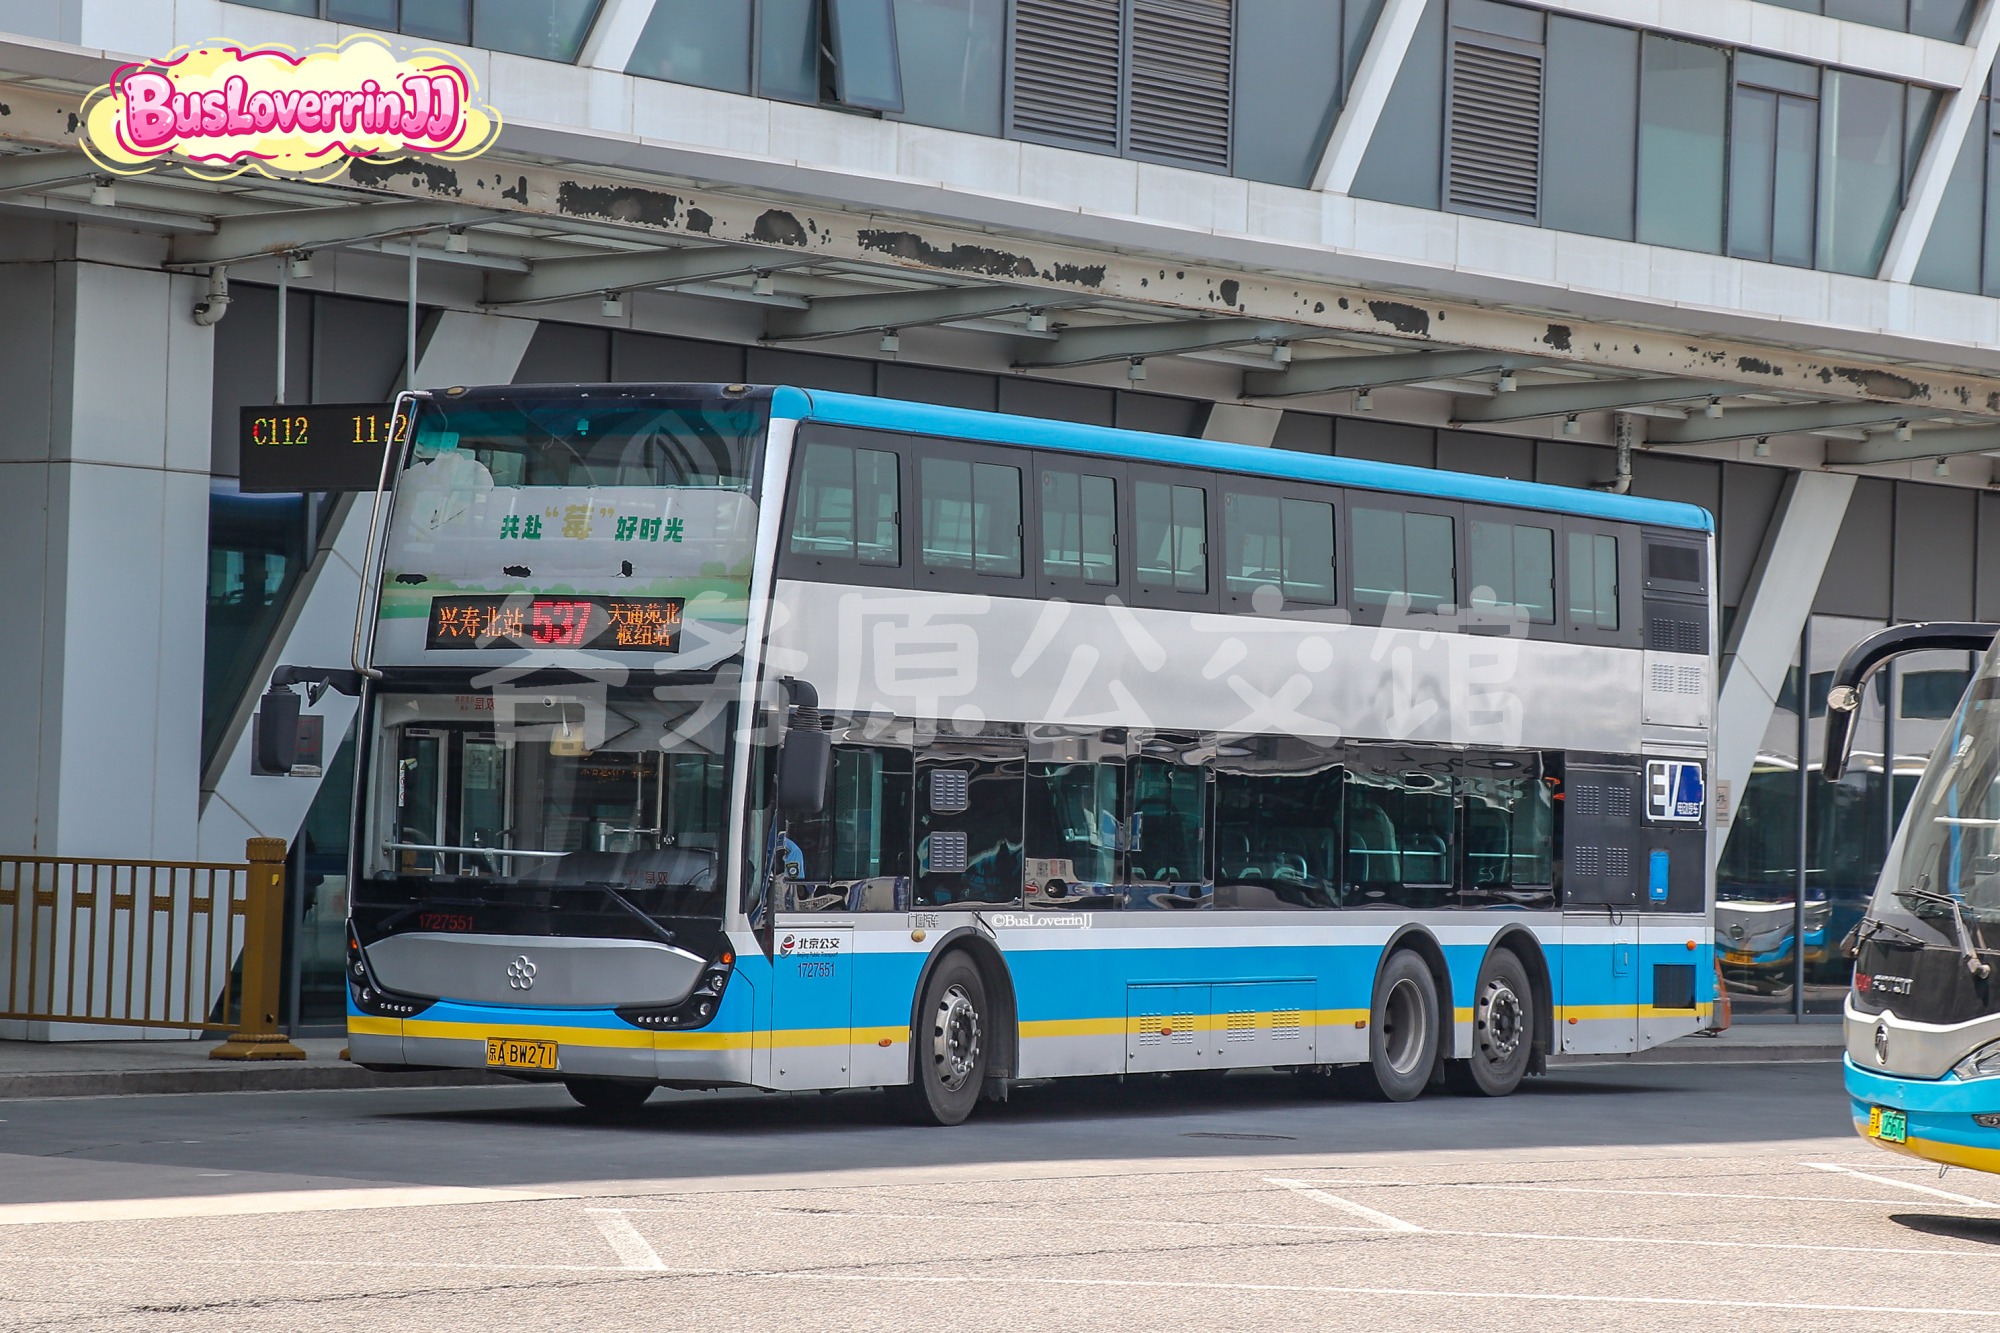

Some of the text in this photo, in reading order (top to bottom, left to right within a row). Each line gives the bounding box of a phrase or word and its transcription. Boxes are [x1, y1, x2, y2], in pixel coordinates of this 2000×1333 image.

[253, 416, 308, 445] C112
[438, 601, 592, 645] 兴寿北站 537
[607, 603, 681, 626] 天通苑北
[616, 624, 671, 647] 枢纽站
[419, 914, 474, 931] 1727551
[798, 938, 840, 949] 北京公交
[797, 962, 835, 978] 1727551
